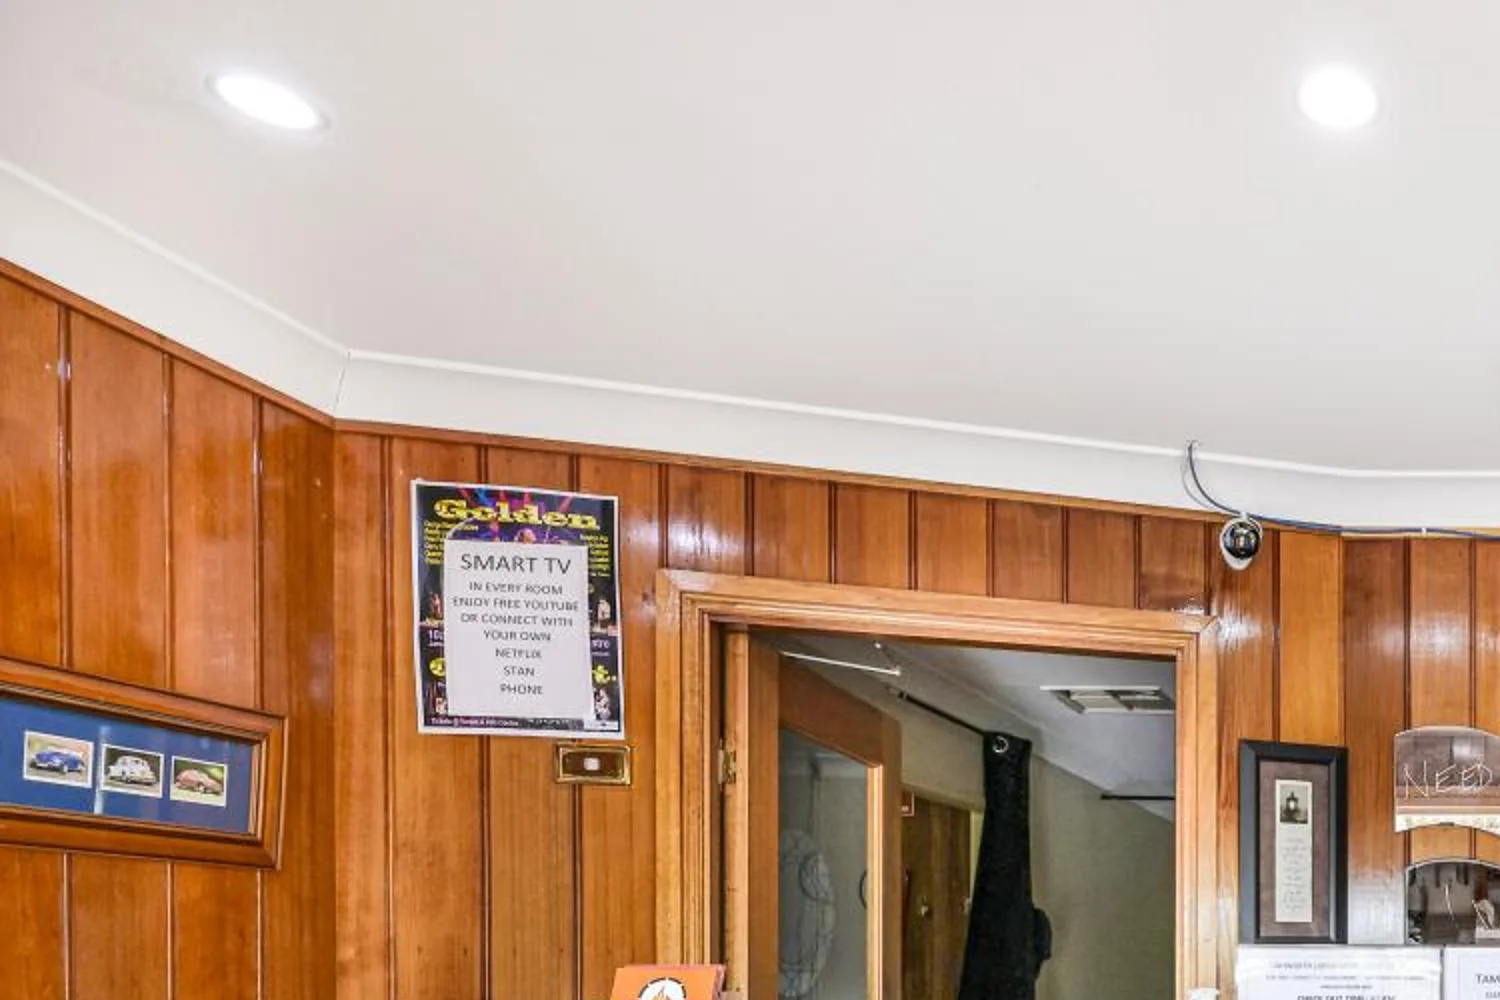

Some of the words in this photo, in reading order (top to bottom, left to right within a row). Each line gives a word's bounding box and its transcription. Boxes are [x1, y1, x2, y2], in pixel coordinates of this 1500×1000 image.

[434, 499, 600, 530] Golden
[460, 553, 538, 574] SMART
[544, 556, 573, 576] TV
[469, 582, 482, 592] IN
[486, 582, 521, 594] EVERY
[525, 584, 563, 596] ROOM
[453, 597, 491, 608] ENJOY
[493, 598, 520, 610] FREE
[523, 599, 579, 613] YOUTUBE
[460, 613, 479, 623] OR
[481, 613, 538, 626] CONNECT
[541, 616, 573, 628] WITH
[483, 629, 517, 641] YOUR
[520, 630, 552, 642] OWN
[495, 648, 542, 659] NETFLIX
[503, 665, 535, 677] STAN
[500, 683, 543, 695] PHONE
[1403, 760, 1493, 800] NEED
